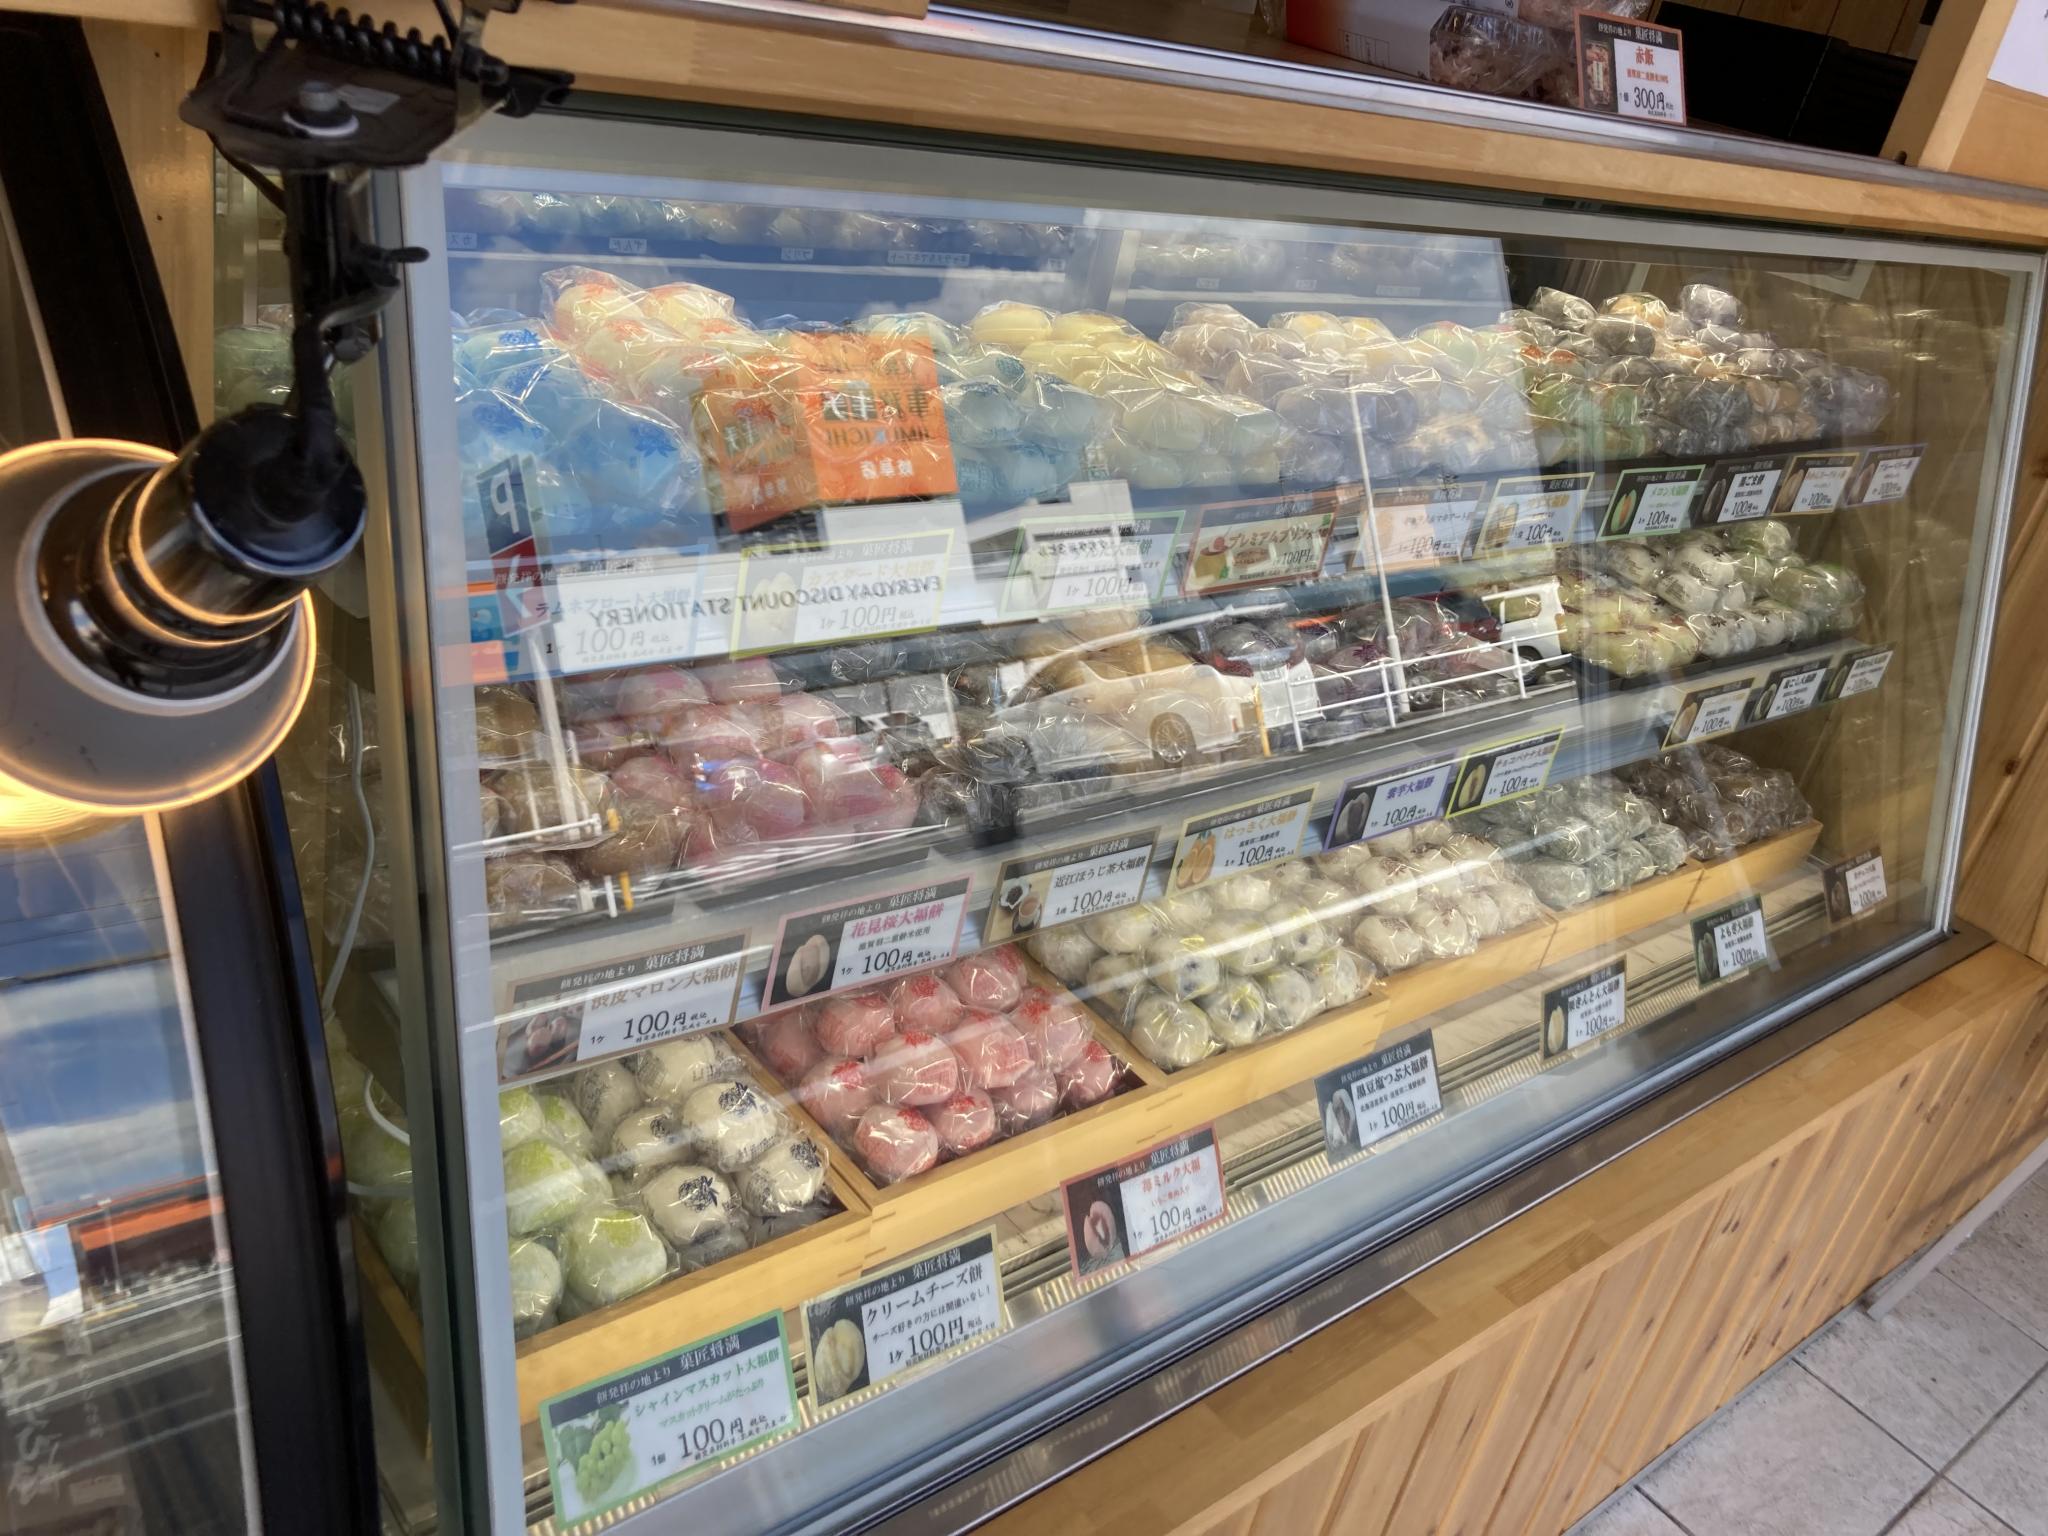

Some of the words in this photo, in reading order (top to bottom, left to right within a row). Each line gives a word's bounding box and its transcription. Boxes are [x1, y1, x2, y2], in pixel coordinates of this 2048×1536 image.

[1634, 46, 1654, 66] 赤飯
[1633, 86, 1664, 111] 300円
[1645, 509, 1672, 525] 100円
[839, 604, 897, 630] 100円
[576, 627, 645, 656] 100円
[1498, 772, 1530, 794] 100円
[1382, 802, 1418, 826] 100円
[1237, 840, 1275, 866] 100円
[1053, 855, 1146, 888] 近江ほうじ茶大福餅
[1069, 885, 1115, 913] 100円
[850, 902, 944, 939] 花見桜大福餅
[861, 943, 914, 975] 100円
[1730, 944, 1752, 967] 100円
[590, 962, 738, 1012] 渋皮マロン大福餅
[622, 1004, 688, 1040] 100円
[1585, 1011, 1607, 1036] 100円
[1355, 1054, 1428, 1100] 黒豆塩つぶ大福餅
[1381, 1096, 1415, 1129] 100円
[1150, 1200, 1192, 1235] 100円
[865, 1262, 984, 1327] クリームチーズ餅
[907, 1314, 965, 1357] 100円
[633, 1346, 780, 1418] シャインマスカット大福餅
[677, 1408, 744, 1459] 100円
